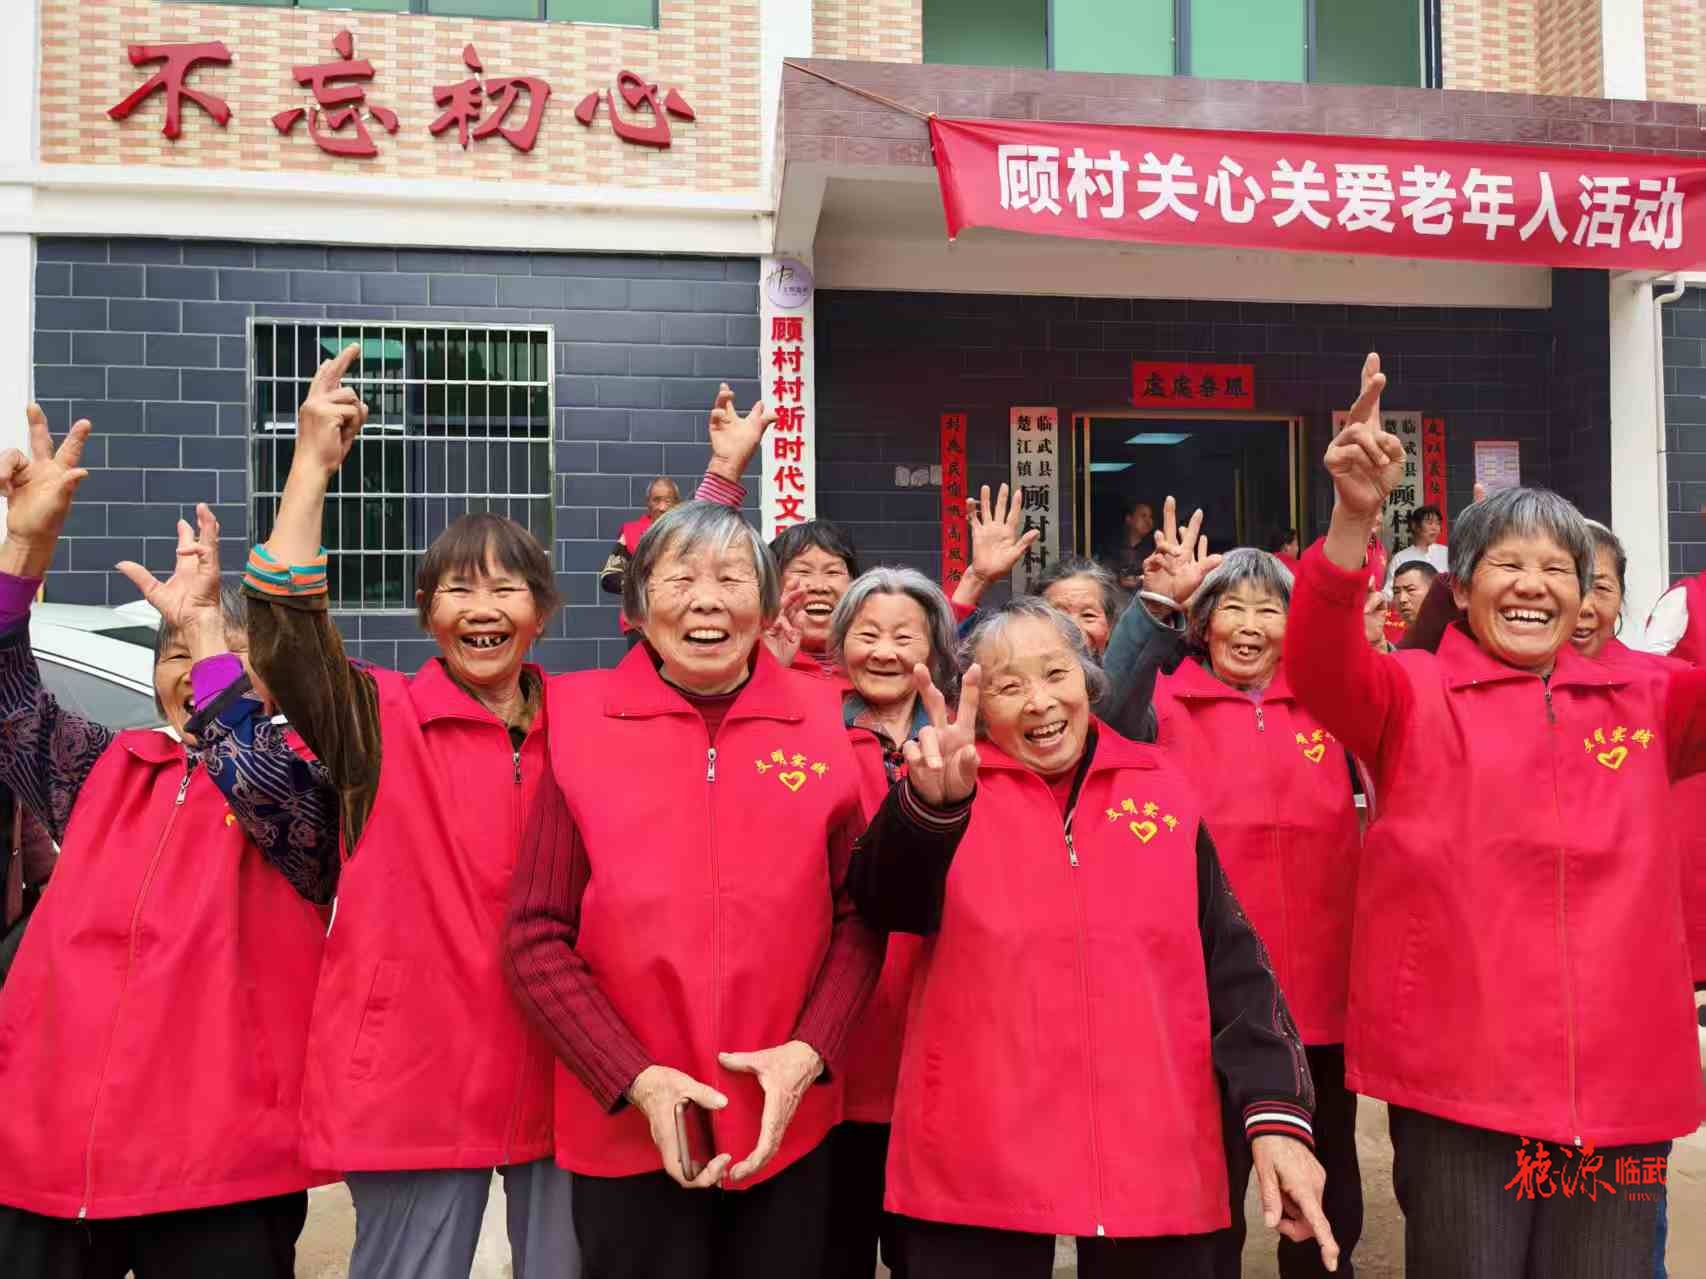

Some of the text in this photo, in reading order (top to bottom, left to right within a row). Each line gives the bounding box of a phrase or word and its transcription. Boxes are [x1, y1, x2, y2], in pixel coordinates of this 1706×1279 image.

[107, 29, 696, 158] 不忘初心
[997, 143, 1686, 251] 顾村关心关爱老年人活动
[1017, 416, 1032, 477] 楚江镇
[1037, 416, 1053, 477] 临武县
[1022, 484, 1050, 590] 顾村村
